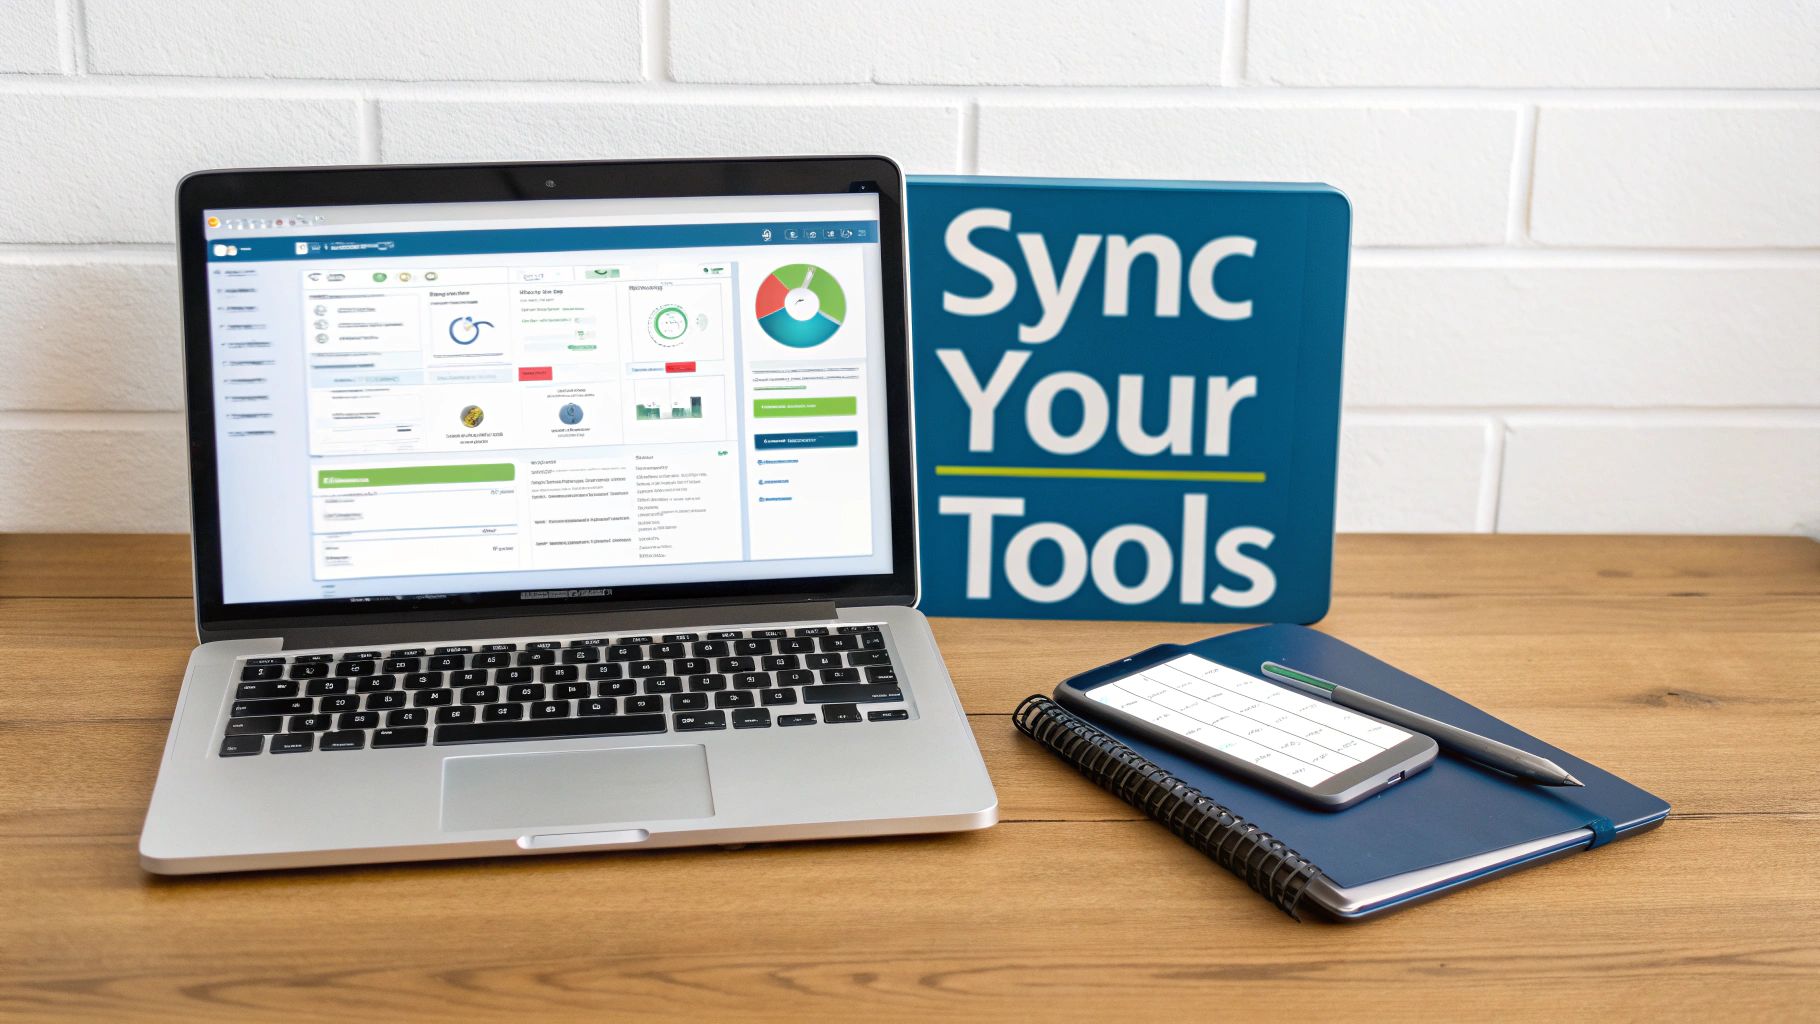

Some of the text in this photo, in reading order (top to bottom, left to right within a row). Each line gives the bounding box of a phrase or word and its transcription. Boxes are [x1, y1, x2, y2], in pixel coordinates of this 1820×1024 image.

[942, 208, 1256, 343] Sync
[936, 349, 1257, 456] Your
[938, 494, 1277, 607] Tools
